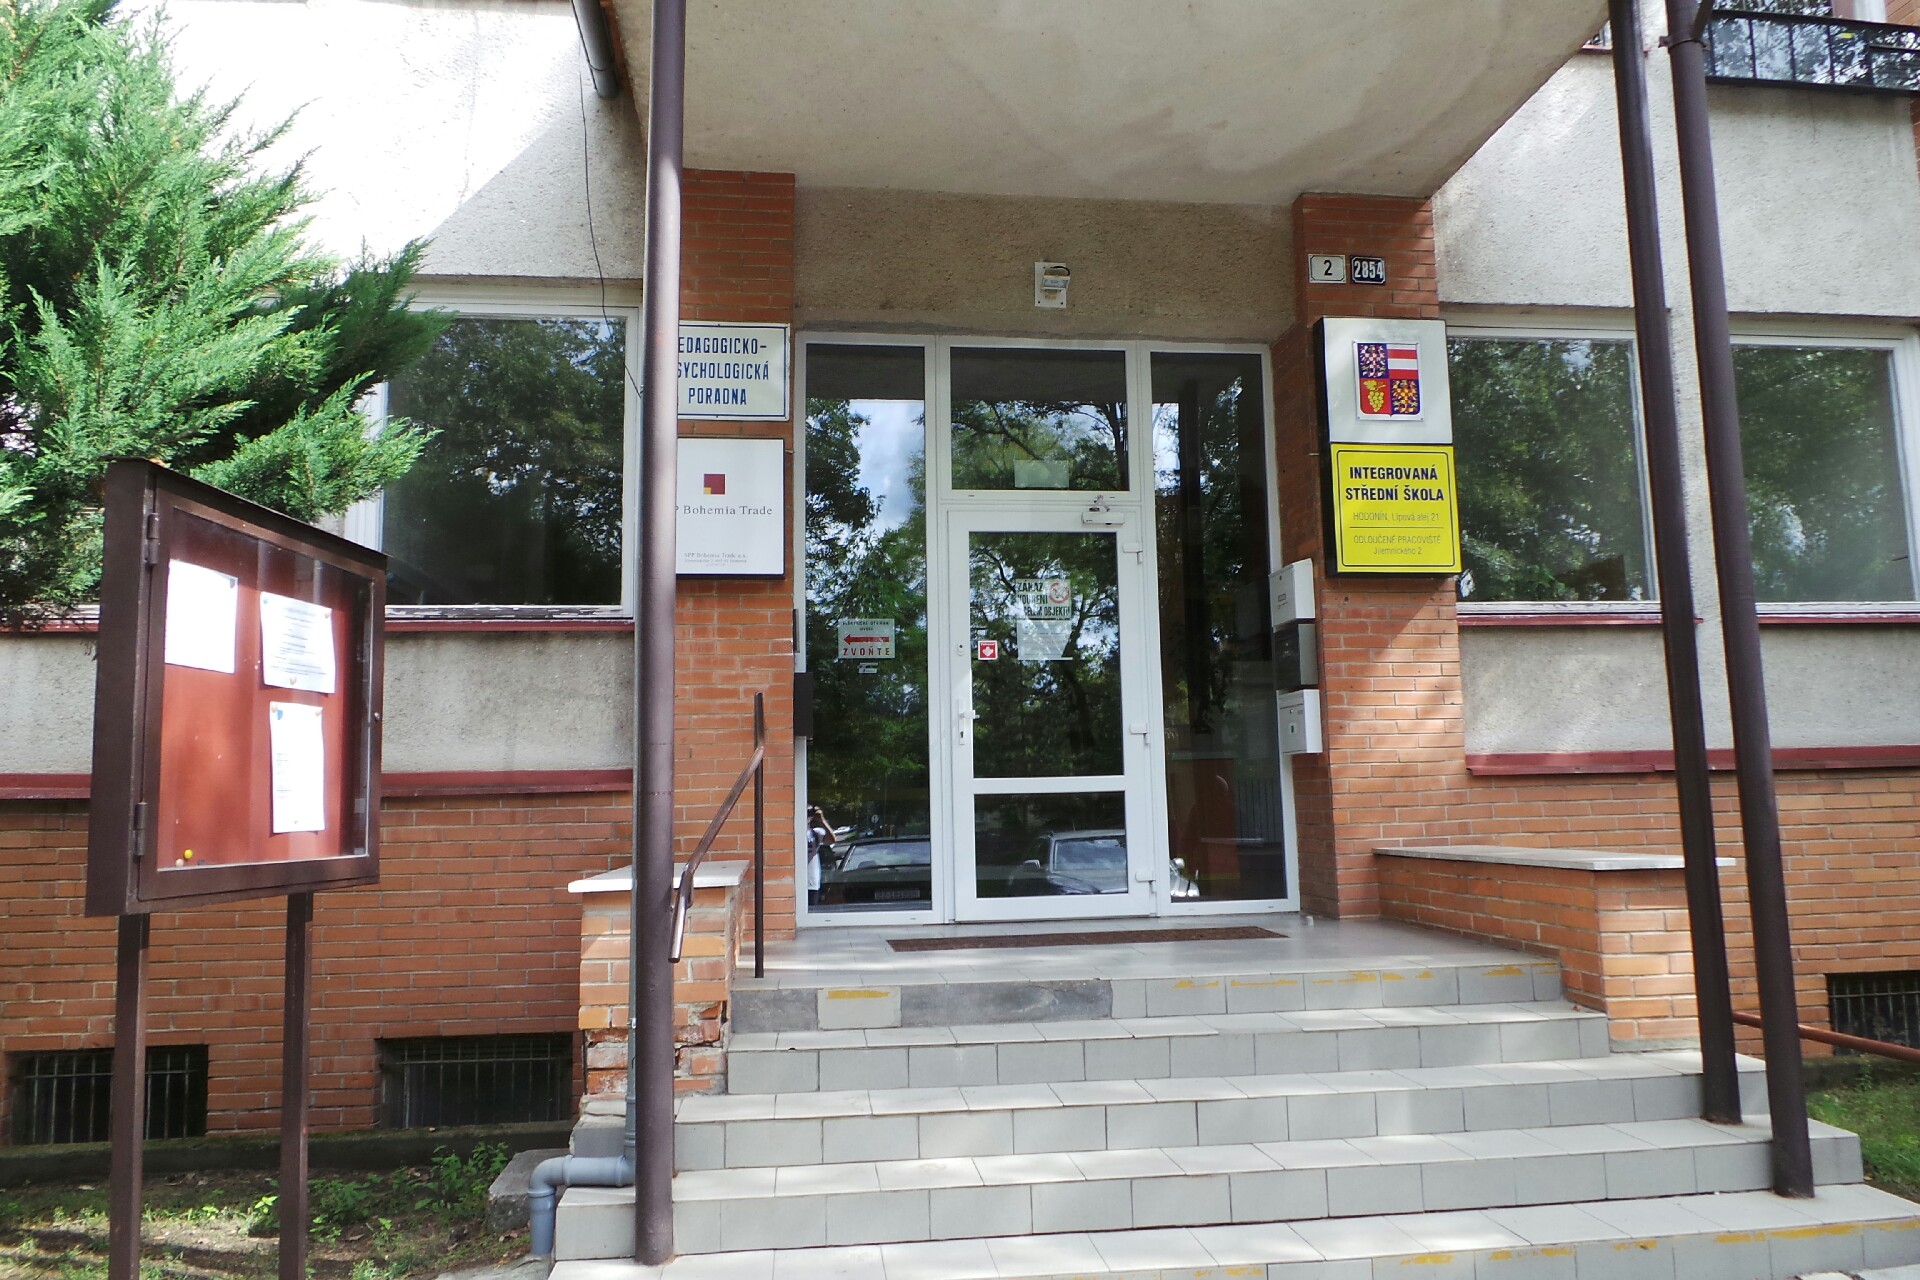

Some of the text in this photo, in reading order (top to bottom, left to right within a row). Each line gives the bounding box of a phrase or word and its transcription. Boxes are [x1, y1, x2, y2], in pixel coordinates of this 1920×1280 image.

[1323, 259, 1333, 276] 2
[1353, 260, 1383, 279] 2854
[678, 336, 767, 355] EDAGOGICKO-
[677, 360, 769, 380] SYCHOLOGICKÁ
[688, 387, 747, 405] PORADNA
[1349, 464, 1438, 480] INTEGROVANÁ
[1345, 484, 1445, 501] STŘEDNÍ ŠKOLA
[683, 505, 736, 515] Bohemia
[739, 505, 773, 515] Trade
[1417, 546, 1422, 555] 2
[843, 646, 890, 656] ZVOŇTE
